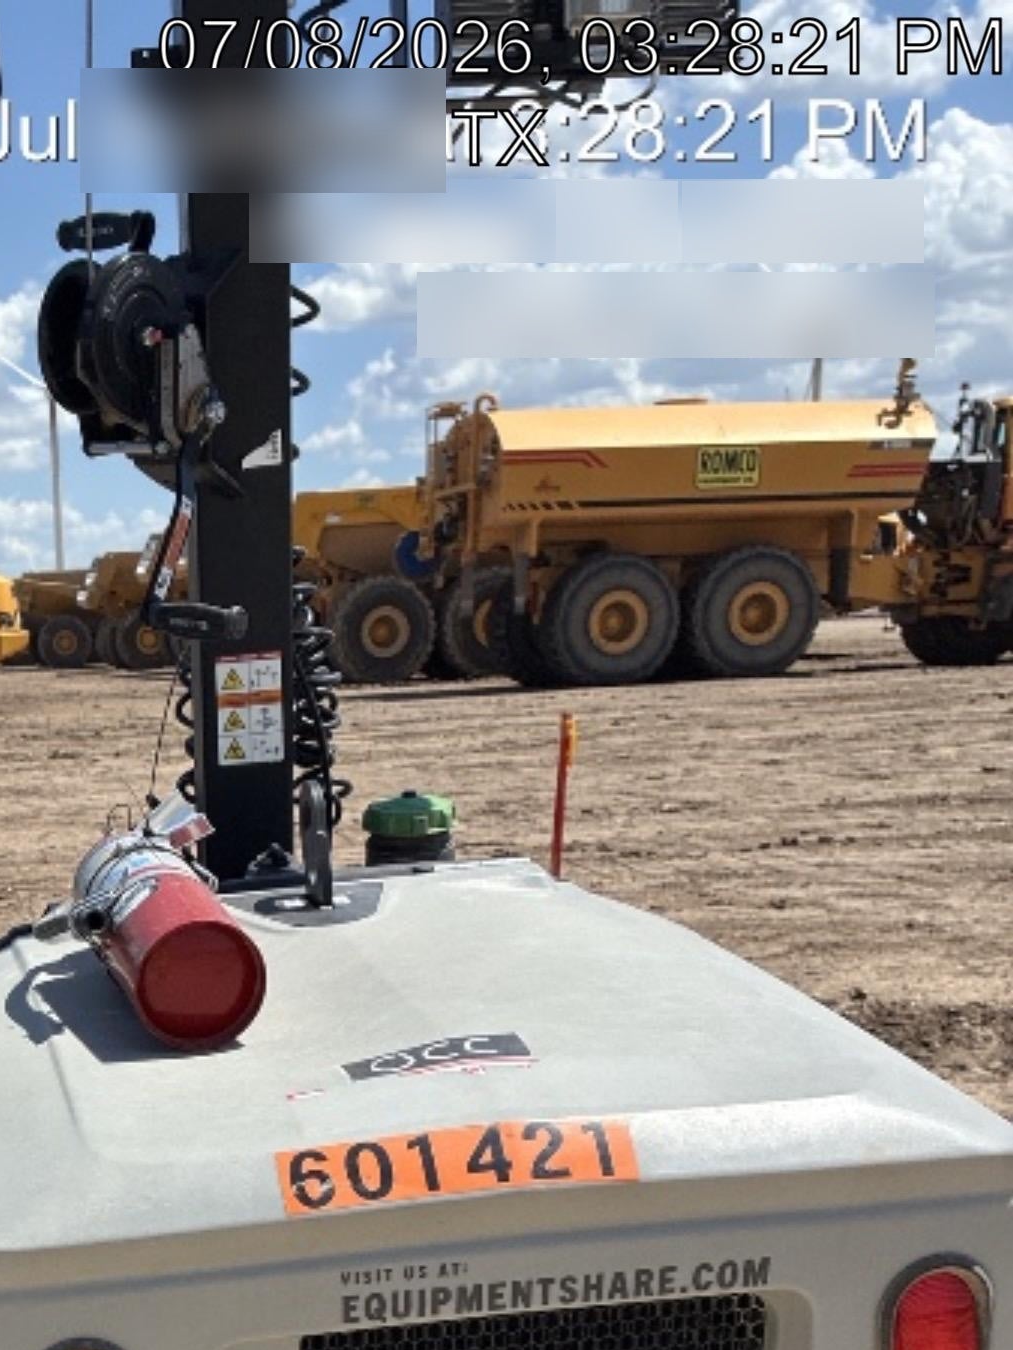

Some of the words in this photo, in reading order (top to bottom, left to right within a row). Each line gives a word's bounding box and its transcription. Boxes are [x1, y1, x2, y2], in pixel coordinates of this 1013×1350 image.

[289, 1121, 616, 1209] 601421
[340, 1267, 393, 1286] VISIT
[403, 1264, 429, 1281] US
[438, 1261, 469, 1278] AT:
[341, 1255, 772, 1323] EQUIPMENTSHARE.COM
